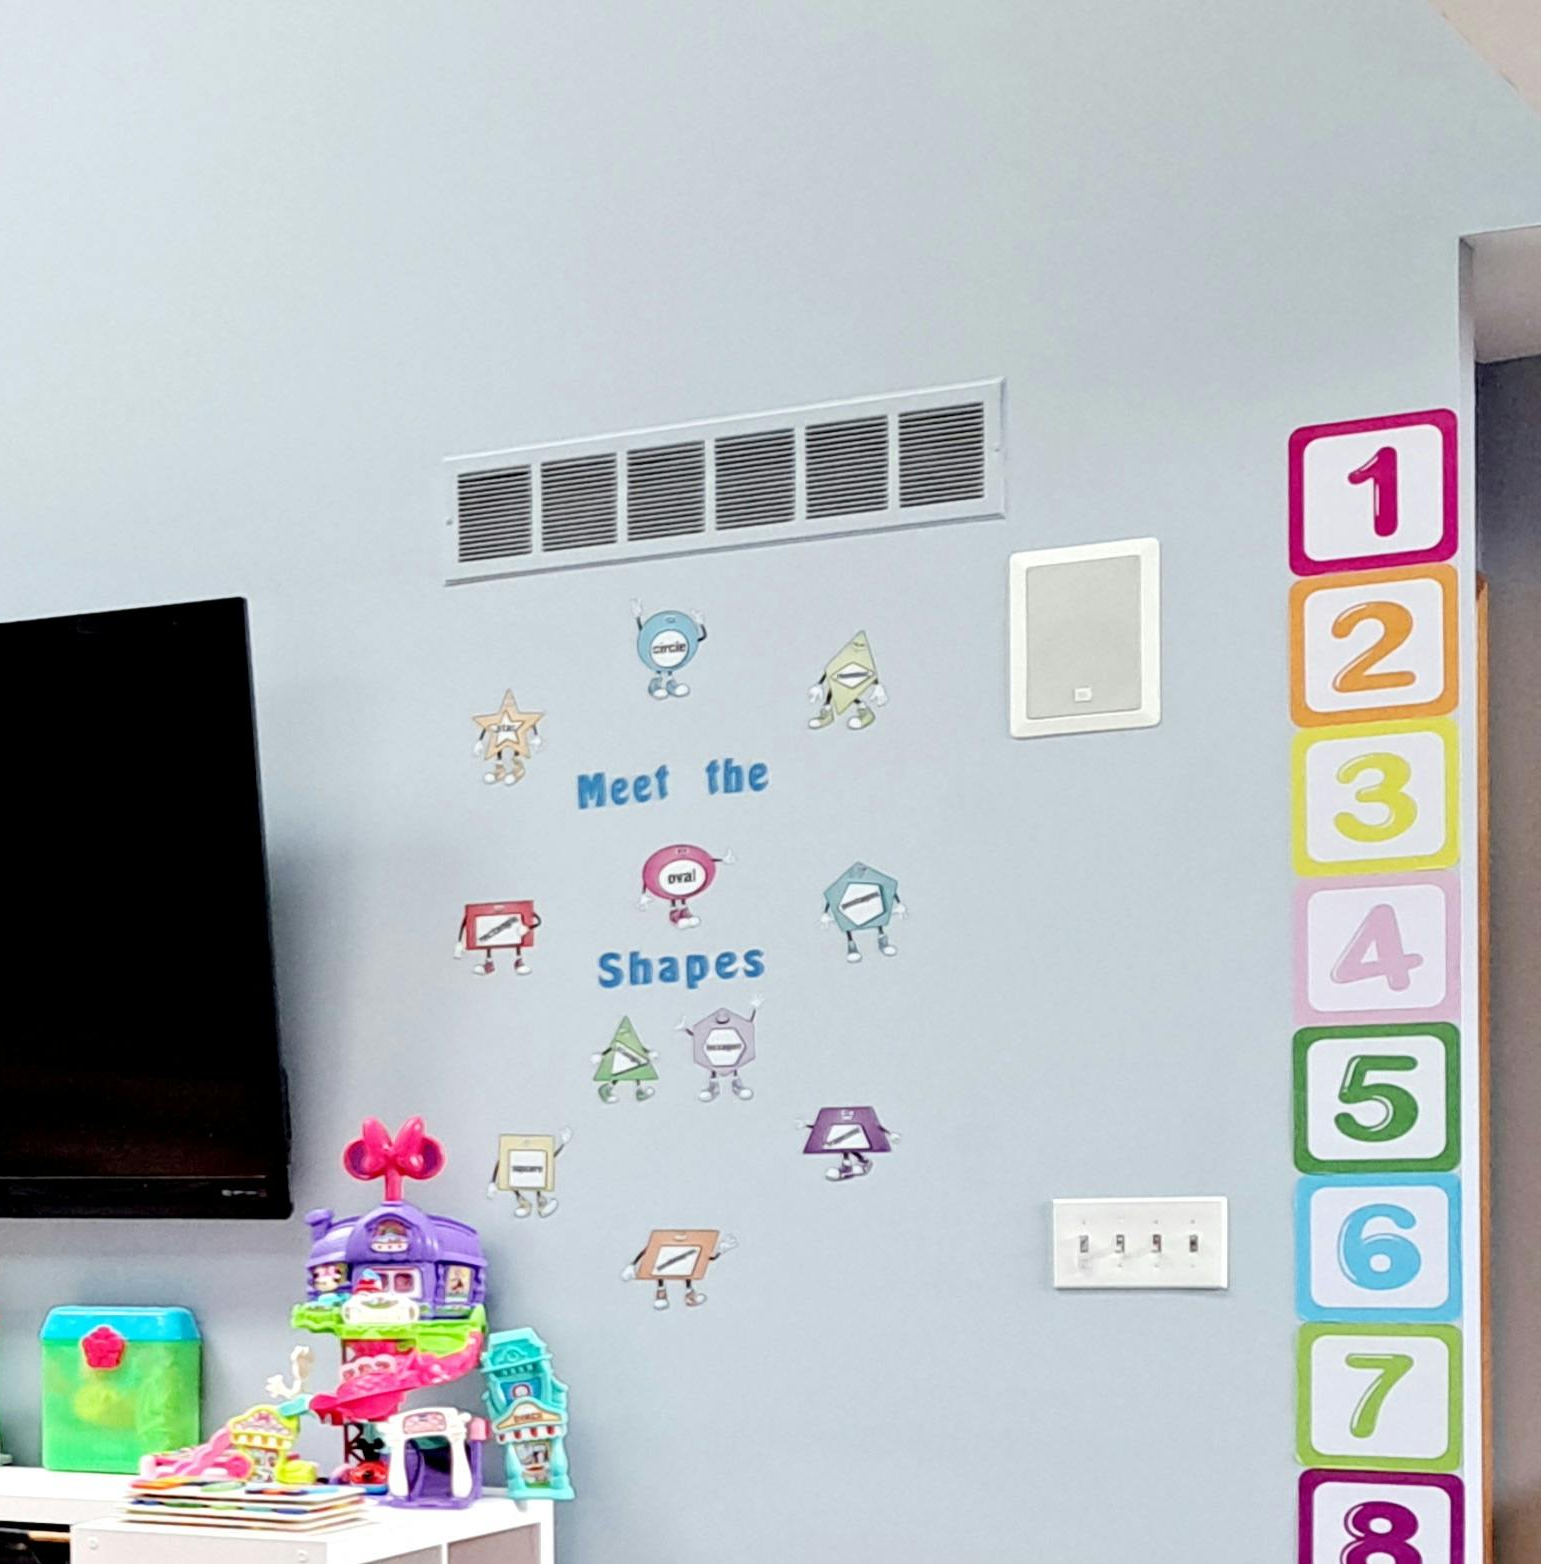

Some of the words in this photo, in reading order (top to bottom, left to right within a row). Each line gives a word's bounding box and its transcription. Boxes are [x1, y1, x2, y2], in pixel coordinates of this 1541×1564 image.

[1348, 446, 1398, 537] 1
[653, 640, 687, 655] circle
[1331, 601, 1416, 693] 2
[577, 764, 670, 810] Meet
[706, 757, 770, 796] the
[1333, 752, 1417, 842] 3
[668, 865, 696, 885] oval
[597, 948, 766, 990] Shapes
[1331, 904, 1423, 991] 4
[1334, 1055, 1418, 1142] 5
[1337, 1203, 1422, 1291] 6
[1344, 1353, 1414, 1438] 7
